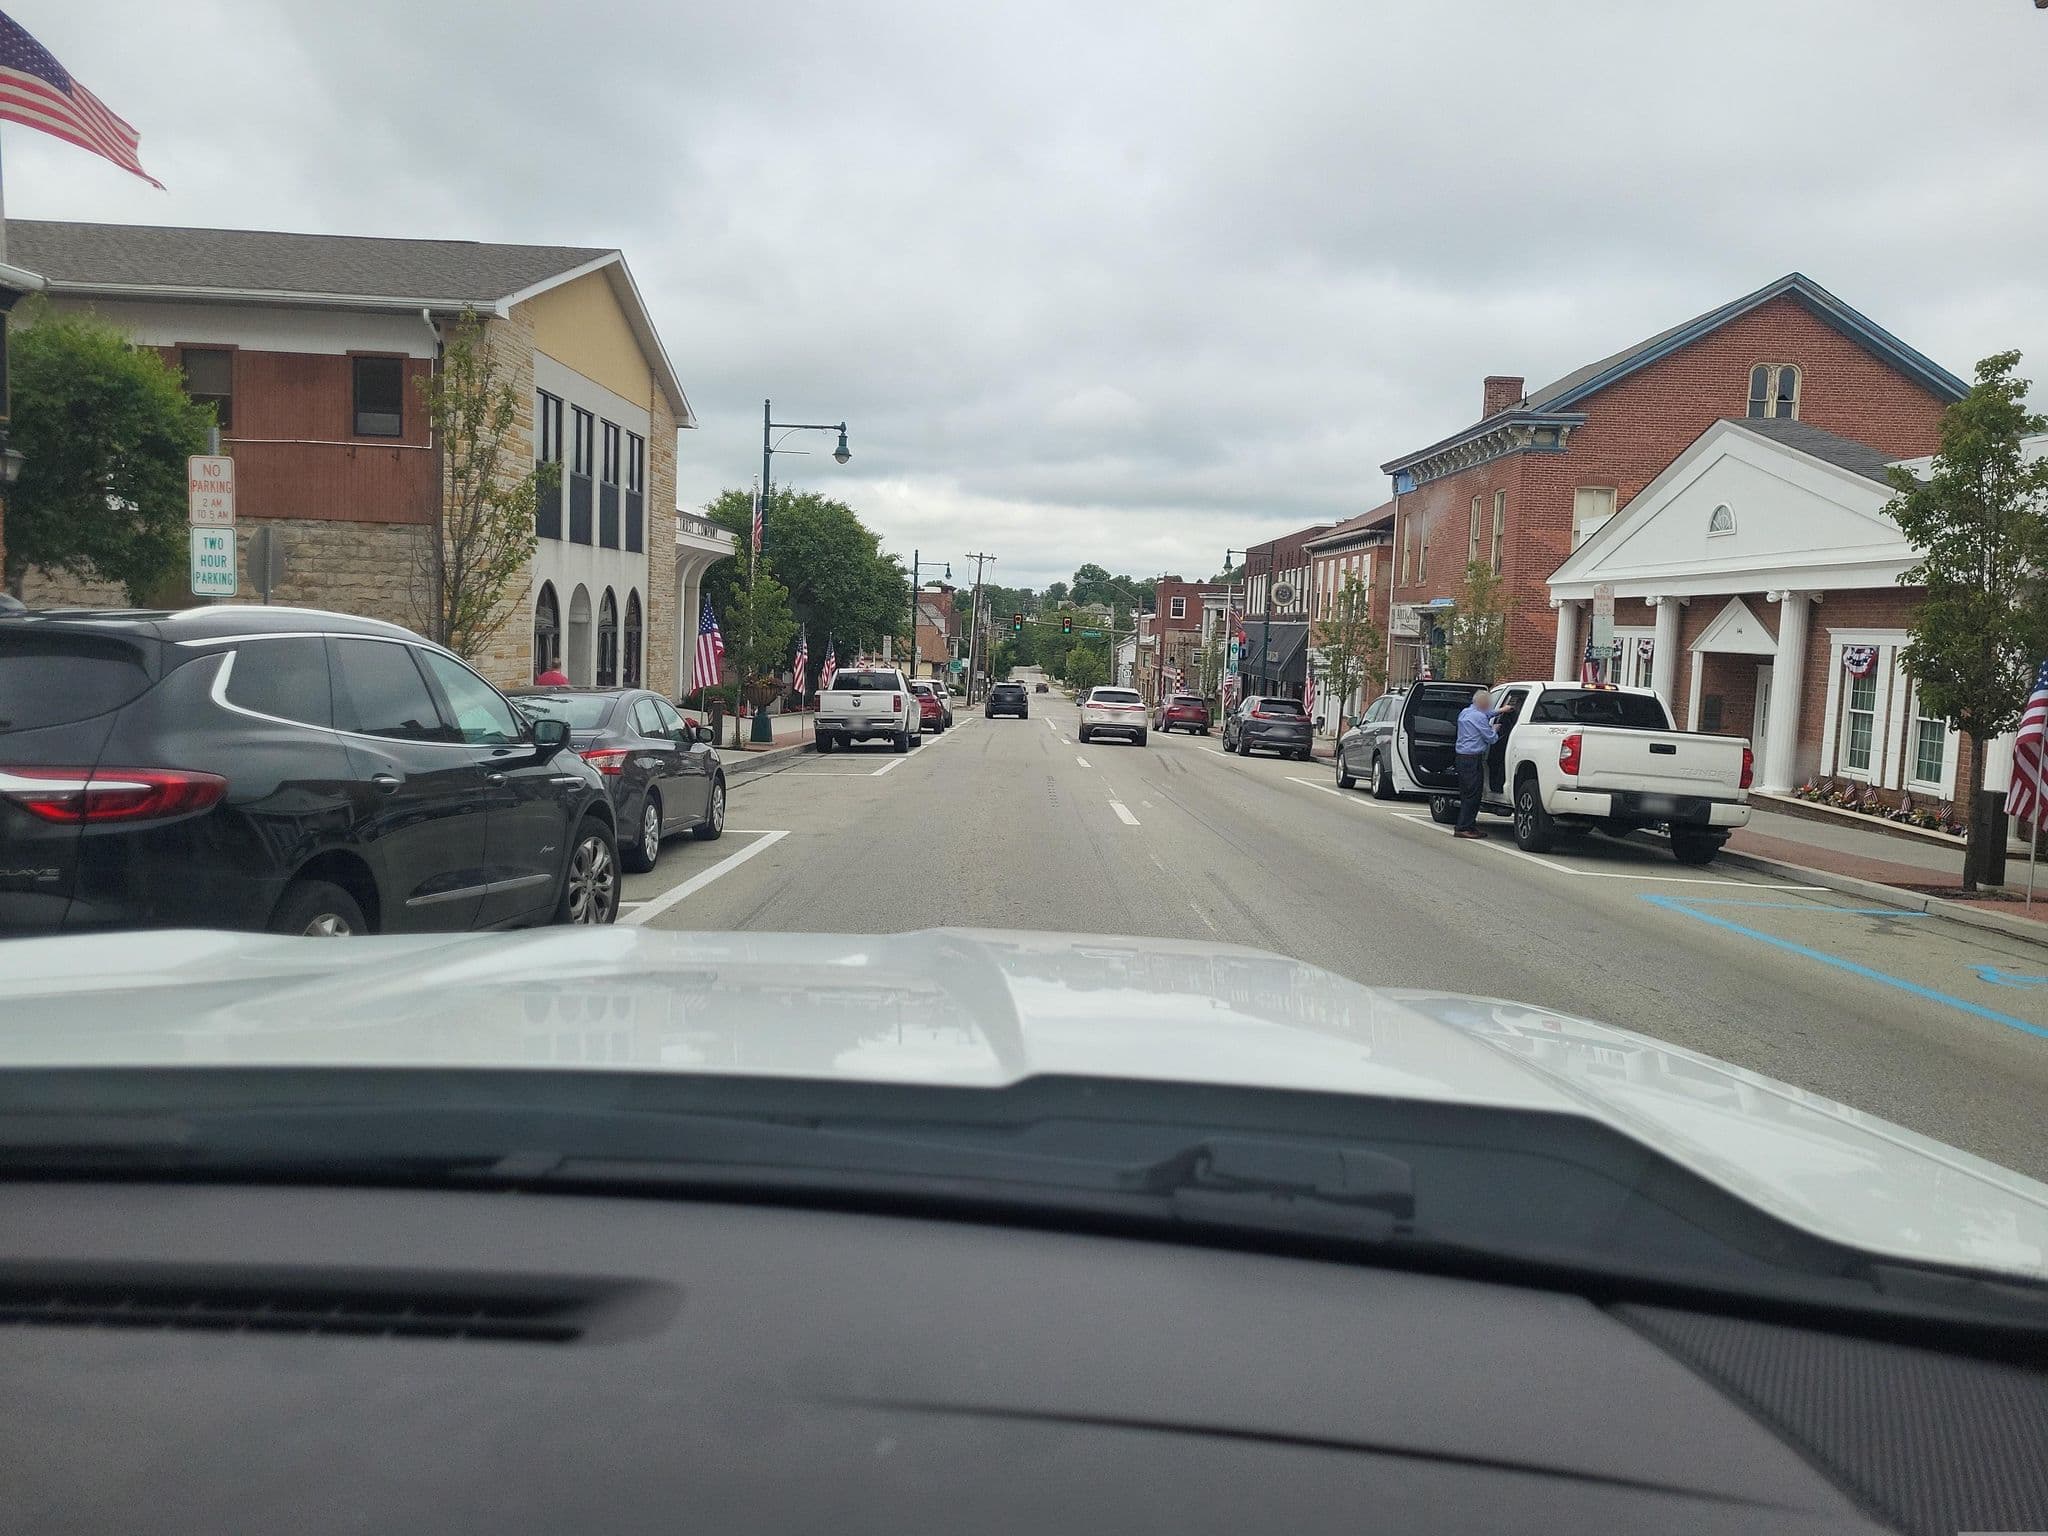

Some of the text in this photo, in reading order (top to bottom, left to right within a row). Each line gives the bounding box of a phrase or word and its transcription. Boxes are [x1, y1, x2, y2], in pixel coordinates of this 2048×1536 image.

[202, 464, 221, 477] NO
[191, 480, 232, 494] PARKING
[202, 498, 223, 508] 2 AM
[197, 510, 229, 519] TO 5 AM
[202, 537, 224, 550] TWO
[200, 555, 227, 568] HOUR
[195, 572, 233, 586] PARKING
